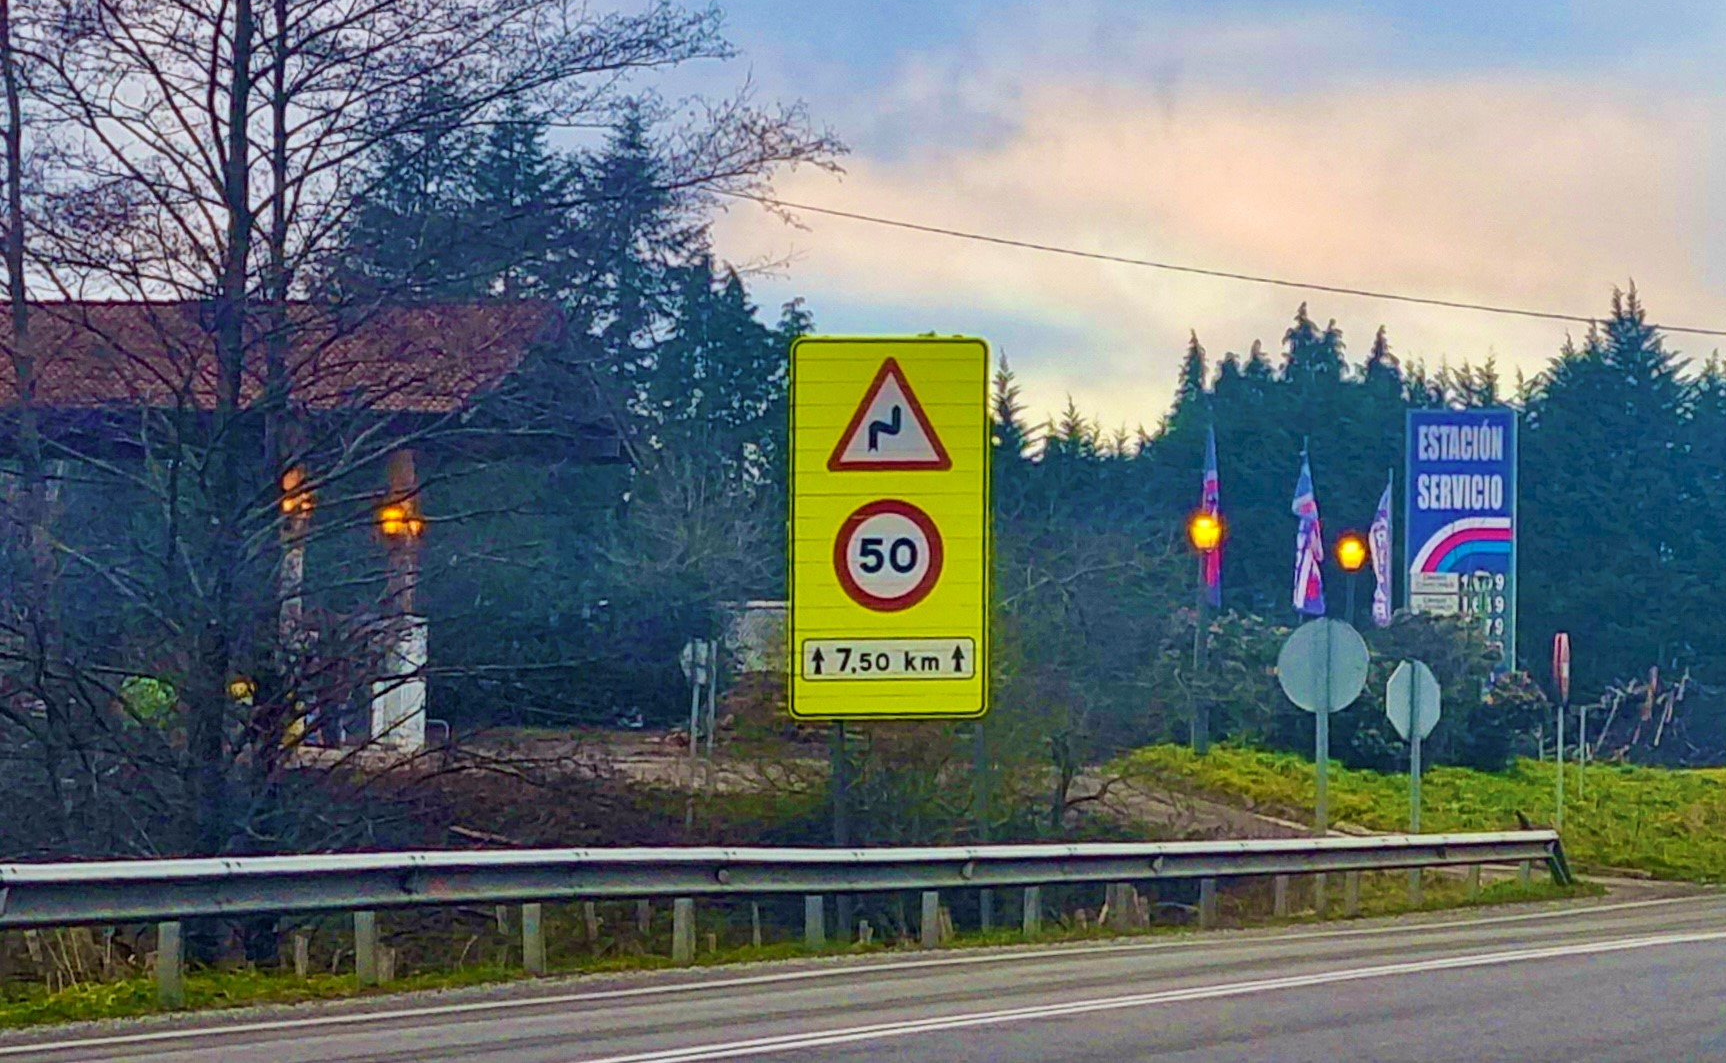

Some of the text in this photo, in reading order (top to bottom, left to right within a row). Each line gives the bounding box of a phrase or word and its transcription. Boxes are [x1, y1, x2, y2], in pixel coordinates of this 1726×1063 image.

[1418, 418, 1504, 462] ESTACIÓN
[1417, 473, 1503, 510] SERVICIO
[859, 537, 918, 574] 50
[904, 651, 940, 672] km
